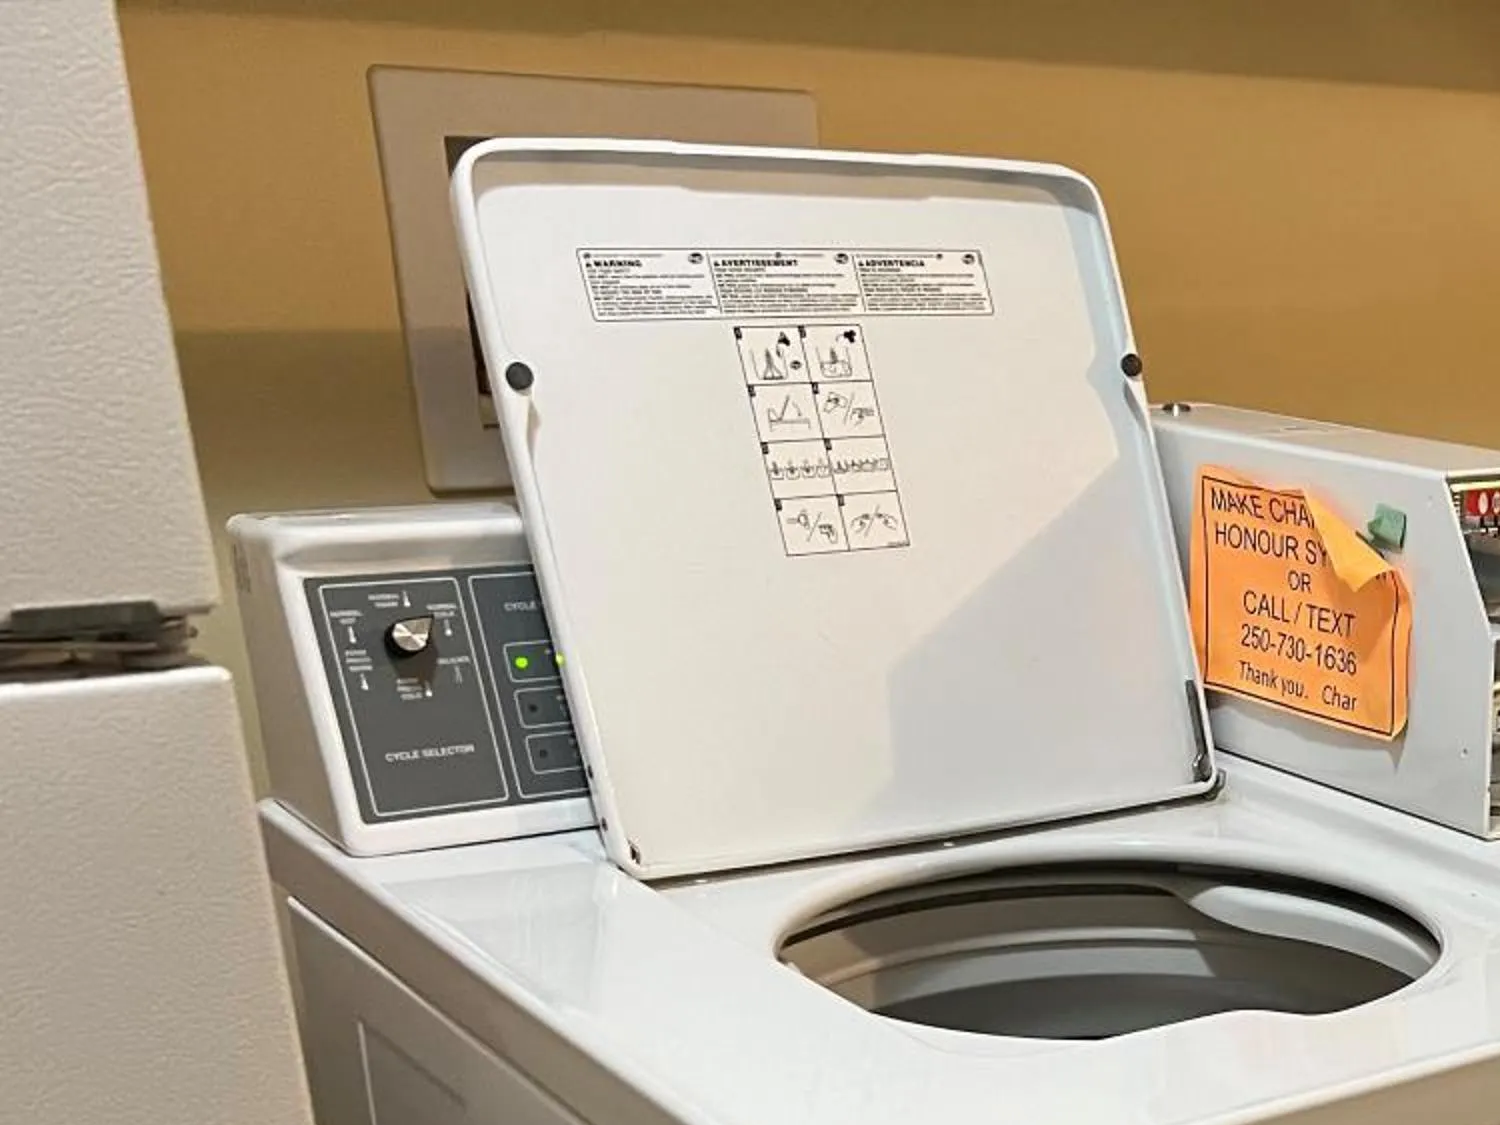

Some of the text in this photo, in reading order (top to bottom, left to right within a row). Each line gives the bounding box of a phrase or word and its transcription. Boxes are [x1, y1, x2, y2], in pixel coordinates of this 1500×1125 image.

[1211, 487, 1263, 518] MAKE
[1215, 522, 1299, 561] HONOUR
[1287, 570, 1312, 593] OR
[1243, 590, 1289, 623] CALL
[1306, 603, 1356, 638] TEXT
[1241, 623, 1357, 676] 250-730-1636
[1238, 660, 1278, 689] Thank
[1322, 685, 1358, 712] Char
